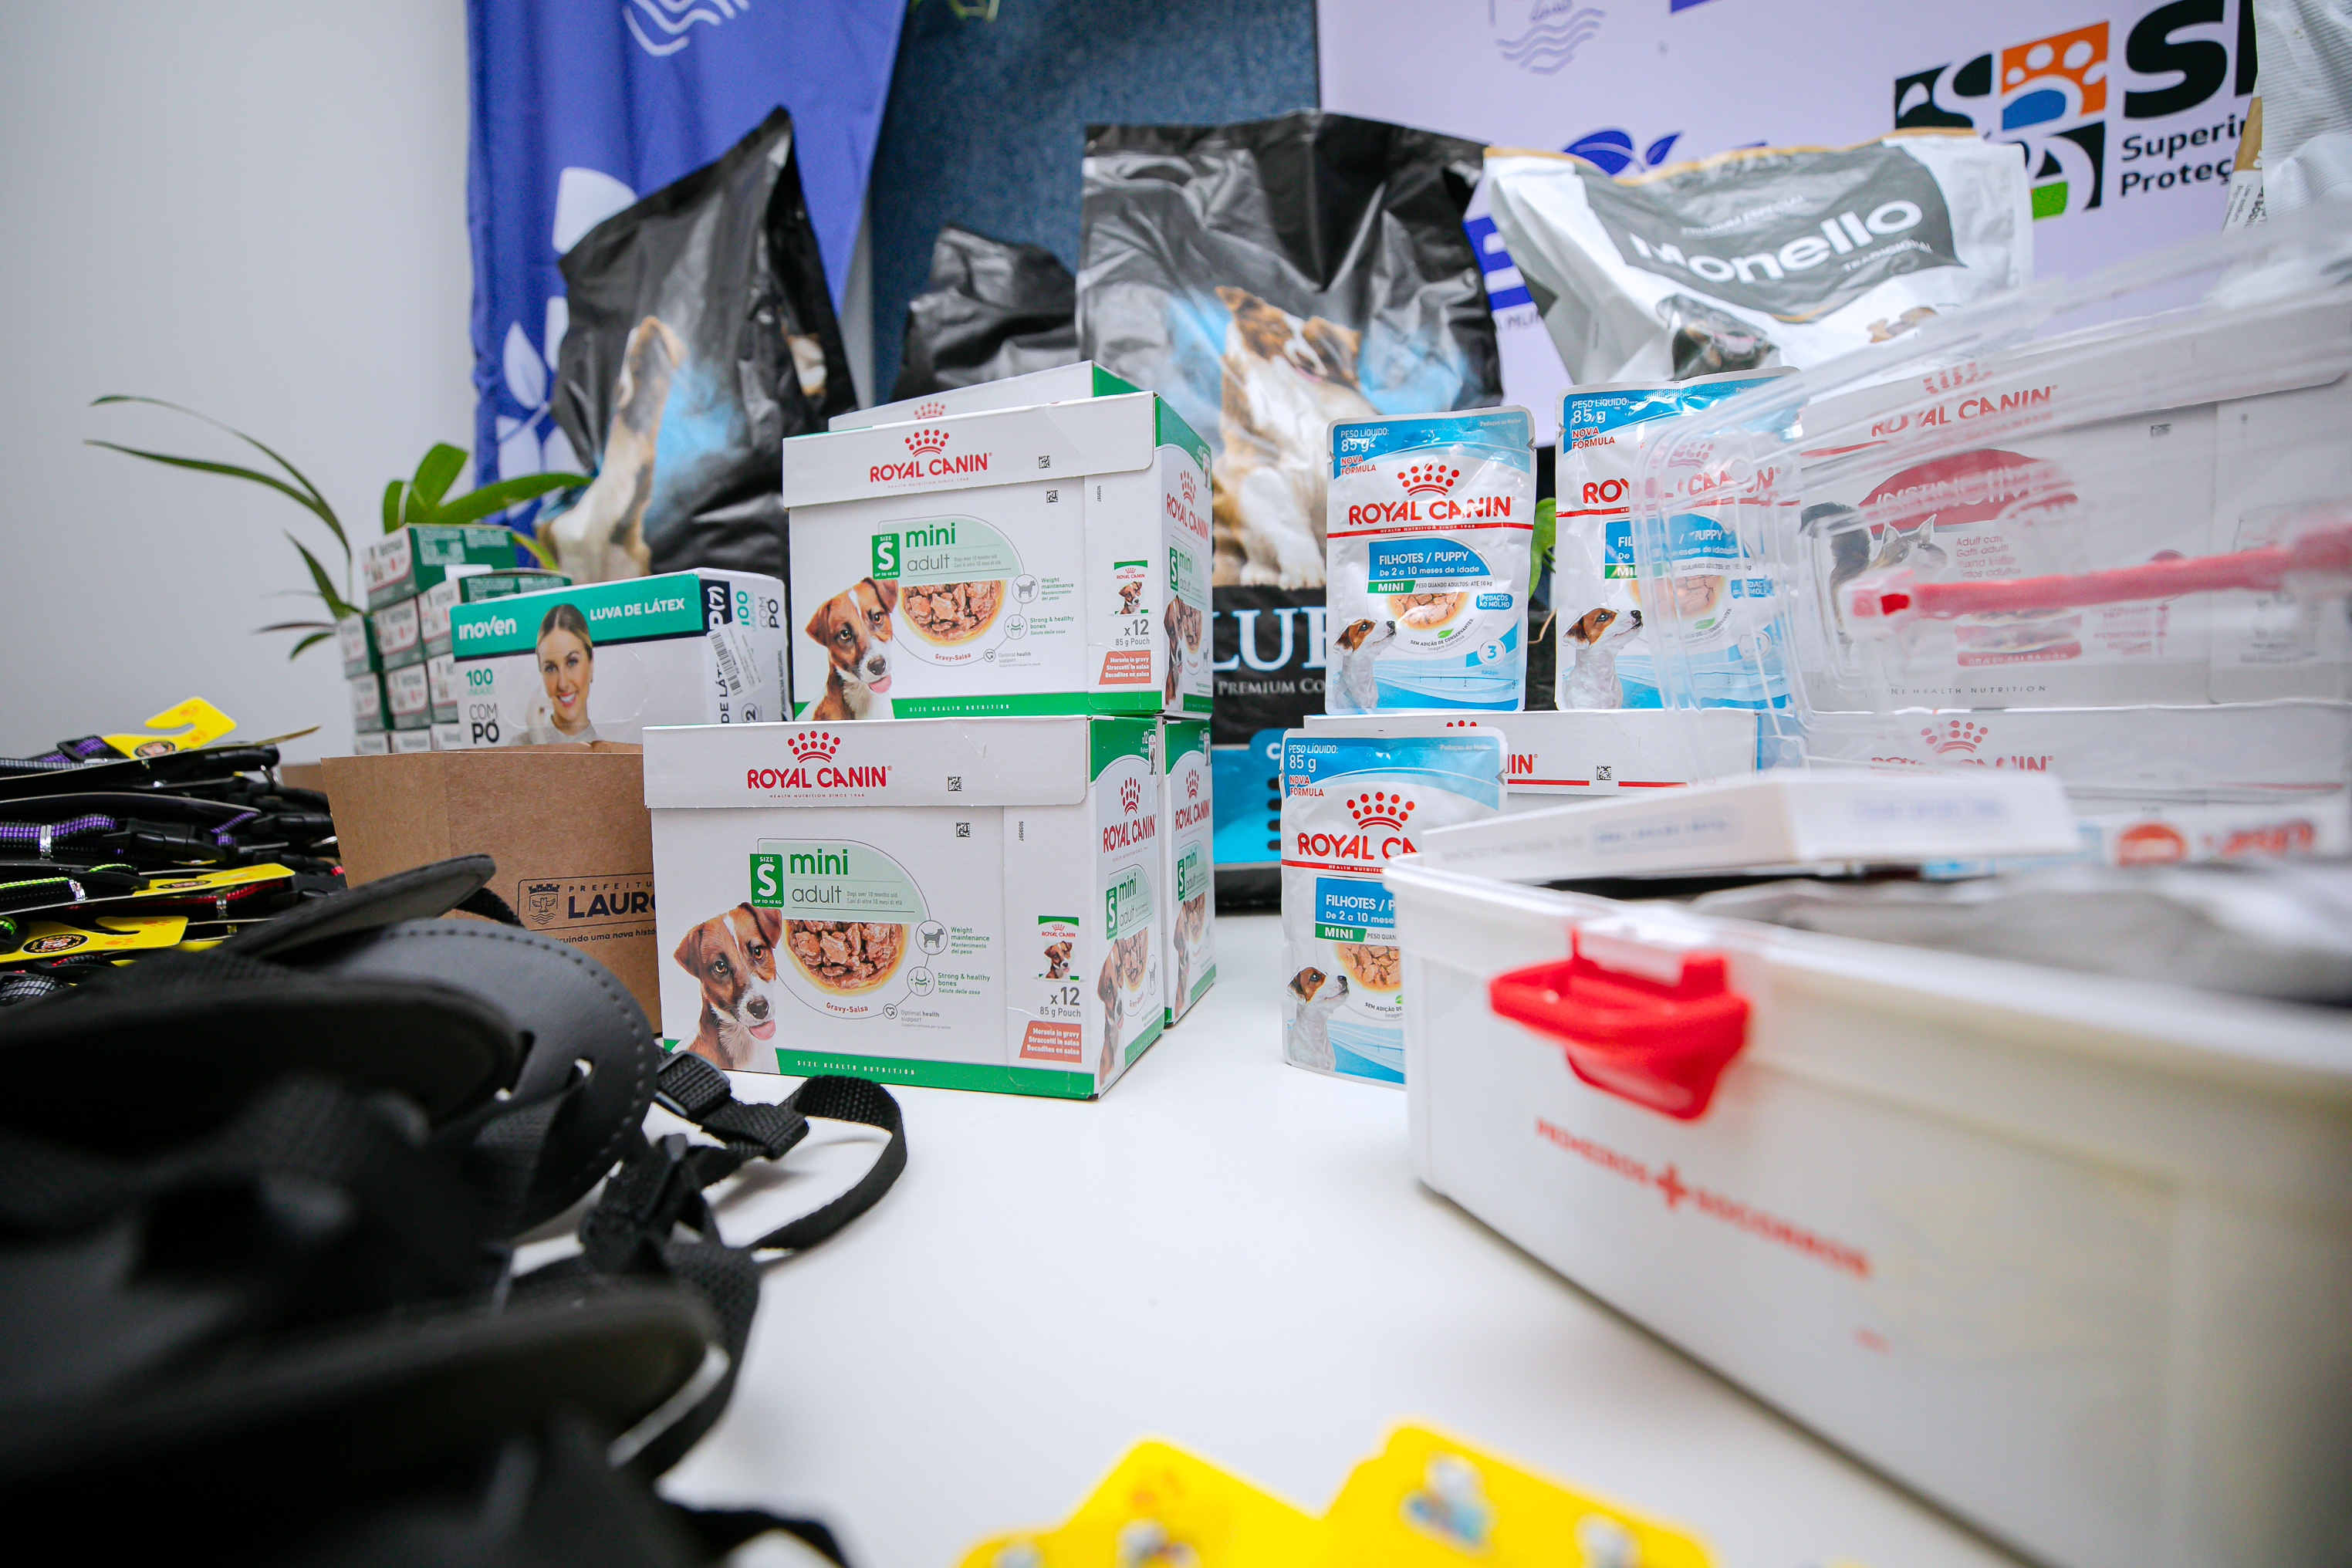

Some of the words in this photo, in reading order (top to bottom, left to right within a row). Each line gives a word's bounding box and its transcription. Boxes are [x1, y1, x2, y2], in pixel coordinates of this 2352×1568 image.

[1629, 200, 1922, 283] Monello
[1572, 400, 1593, 409] PESO
[1958, 386, 2051, 421] CANIN
[1573, 408, 1592, 424] 85
[1340, 429, 1358, 438] PESO
[1360, 427, 1389, 438] LÍQUIDO:
[1572, 427, 1599, 438] NOVA
[1572, 437, 1615, 449] FÓRMULA
[870, 461, 924, 482] ROYAL
[929, 453, 987, 476] CANIN
[1340, 455, 1364, 465] NOVA
[1340, 465, 1376, 475] FÓRMULA
[1167, 492, 1188, 528] ROYAL
[1188, 511, 1208, 541] CANIN
[1349, 500, 1422, 525] ROYAL
[1428, 496, 1511, 522] CANIN
[906, 522, 955, 548] mini
[1956, 536, 1981, 546] Adult
[877, 542, 894, 570] S
[1379, 553, 1424, 565] FILHOTES
[1435, 551, 1468, 562] PUPPY
[1981, 544, 2009, 555] adulti
[907, 553, 950, 571] adult
[1179, 552, 1193, 573] mini
[1407, 566, 1417, 575] 10
[1377, 583, 1404, 592] MINI
[590, 606, 622, 620] LUVA
[624, 603, 641, 616] DE
[644, 597, 684, 614] LÁTEX
[735, 590, 750, 626] 100
[758, 596, 769, 628] COM
[766, 599, 780, 629] PÓ
[458, 616, 516, 640] inoven
[1124, 619, 1149, 636] x12
[935, 653, 971, 661] Gravy-Salsa
[1488, 646, 1496, 658] 3
[465, 667, 493, 687] 100
[1217, 680, 1296, 694] PREMIUM
[1971, 685, 2046, 694] NUTRITION
[469, 702, 498, 722] COM
[471, 718, 499, 745] PÓ
[1289, 745, 1306, 753] PESO
[1307, 743, 1339, 754] LÍQUIDO:
[1289, 755, 1304, 769] 85
[1309, 758, 1316, 772] g
[747, 768, 812, 789] ROYAL
[816, 766, 886, 788] CANIN
[1289, 775, 1310, 785] NOVA
[1290, 786, 1324, 797] FÓRMULA
[1175, 804, 1193, 831] ROYAL
[1194, 799, 1210, 823] CANIN
[1103, 821, 1130, 853] ROYAL
[1132, 816, 1155, 843] CANIN
[1297, 833, 1374, 860] ROYAL
[790, 849, 848, 875] mini
[757, 863, 777, 897] S
[1119, 873, 1137, 902] mini
[792, 885, 842, 904] adult
[1326, 894, 1376, 911] FILHOTES
[1120, 904, 1134, 927] adult
[1325, 927, 1353, 939] MINI
[938, 972, 959, 981] Strong
[1050, 987, 1080, 1005] x12
[826, 1002, 868, 1013] Gravy-Salsa
[1040, 1007, 1049, 1015] 85
[1051, 1009, 1056, 1017] g
[1058, 1008, 1080, 1017] Pouch
[797, 1059, 818, 1068] SIZE
[823, 1063, 857, 1071] HEALTH
